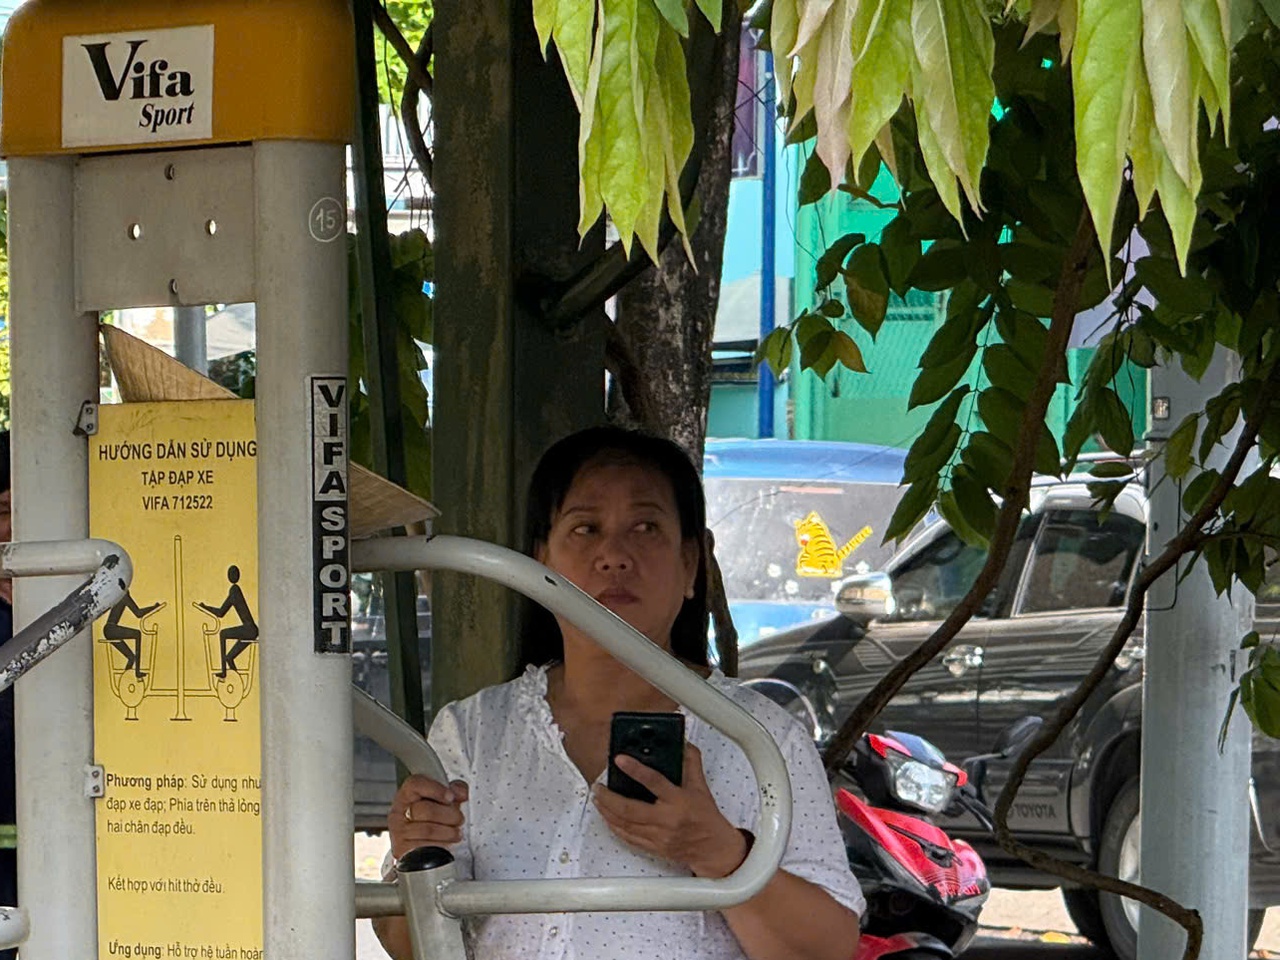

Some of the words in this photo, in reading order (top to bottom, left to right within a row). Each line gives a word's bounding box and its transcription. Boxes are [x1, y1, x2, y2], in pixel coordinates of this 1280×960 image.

[81, 39, 195, 101] Vifa
[139, 102, 195, 132] Sport
[316, 208, 336, 232] 15
[99, 441, 152, 460] HƯỚNG
[191, 438, 212, 458] SỬ
[216, 441, 257, 461] DỤNG
[169, 471, 194, 488] ĐẠP
[198, 471, 213, 484] XE
[143, 497, 169, 510] VIFA
[172, 495, 213, 509] 712522
[320, 506, 347, 646] SPORT
[106, 774, 152, 791] Phương
[157, 774, 187, 791] pháp:
[192, 774, 207, 788] Sử
[212, 776, 237, 792] dụng
[106, 797, 126, 811] đạp
[129, 801, 141, 810] xe
[144, 798, 167, 813] đạp;
[196, 800, 216, 811] trên
[1014, 804, 1056, 818] TOYOTA
[107, 820, 122, 833] hai
[125, 820, 149, 834] chân
[152, 821, 171, 836] đạp
[128, 877, 147, 893] hợp
[150, 878, 166, 891] với
[109, 939, 131, 958] Ứng
[201, 946, 213, 959] hệ
